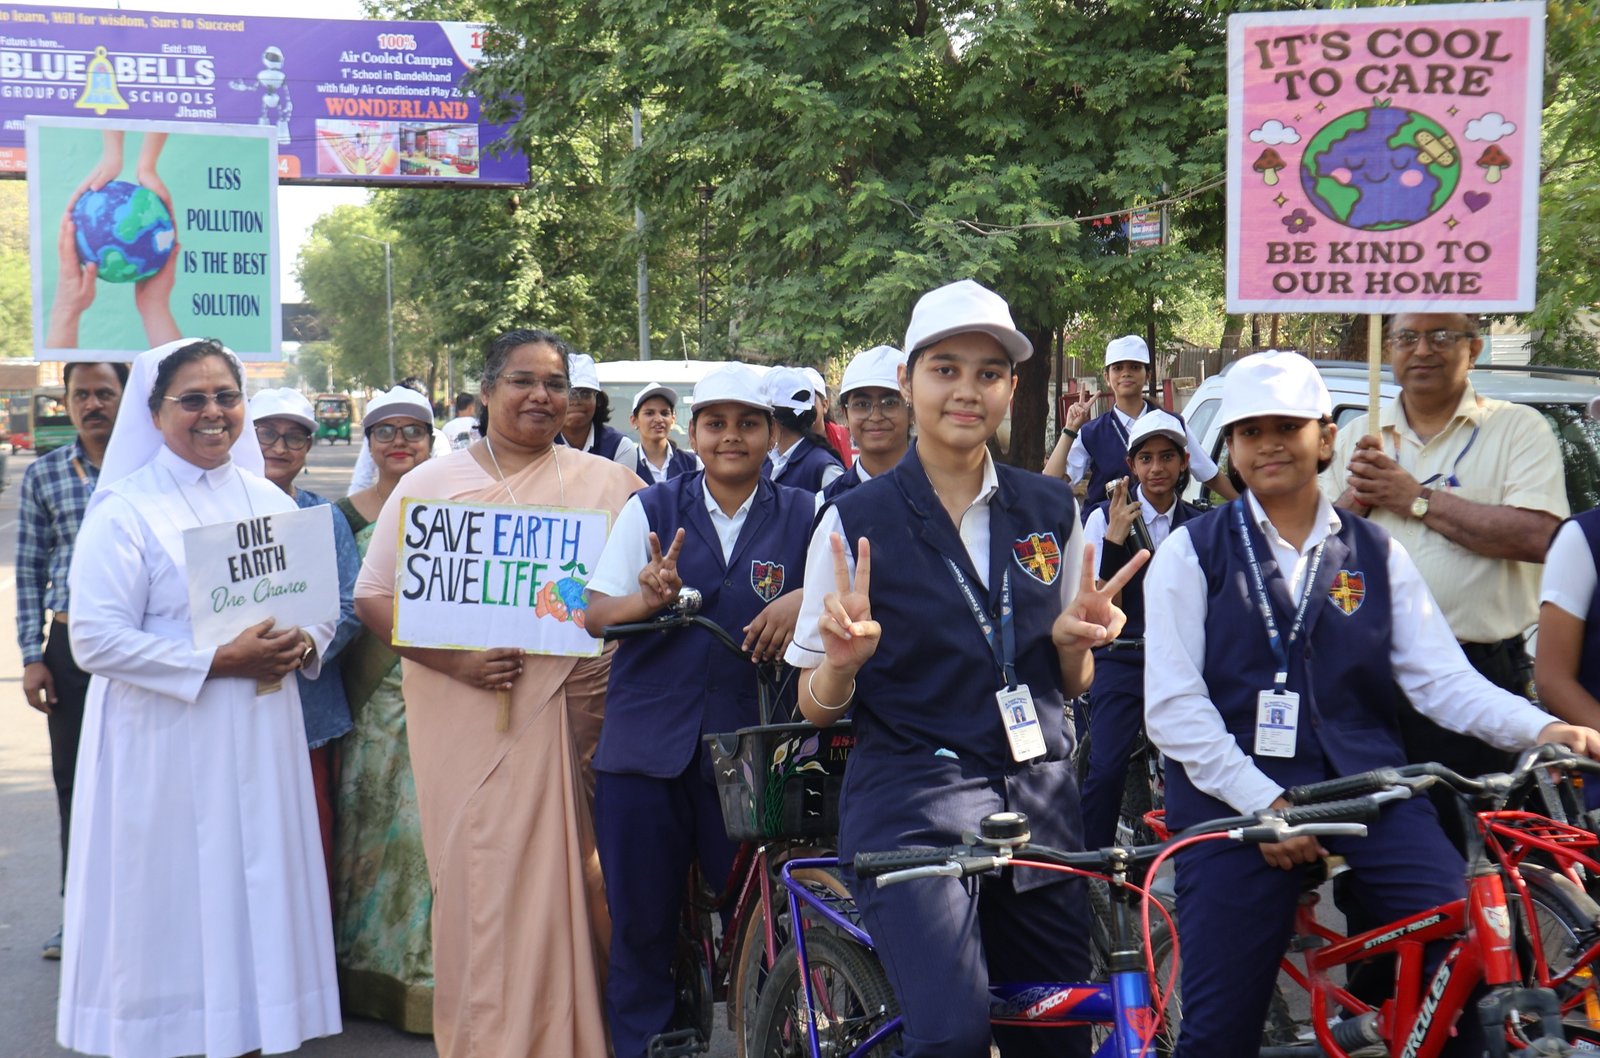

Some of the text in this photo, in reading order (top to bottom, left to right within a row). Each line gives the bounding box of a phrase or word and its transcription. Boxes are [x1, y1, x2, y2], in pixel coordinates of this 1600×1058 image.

[51, 11, 75, 25] Will
[77, 13, 96, 26] for
[99, 14, 148, 29] wisdom,
[150, 16, 178, 29] Sure
[181, 18, 194, 30] to
[196, 18, 244, 32] Succeed
[377, 33, 417, 50] 100%
[1254, 28, 1513, 70] IT'S COOL
[1, 51, 216, 86] BLUE BELLS
[339, 51, 360, 63] Air
[361, 52, 403, 65] Cooled
[405, 54, 453, 68] Campus
[352, 69, 382, 80] School
[383, 70, 393, 80] in
[394, 71, 451, 82] Bundelkhand
[1274, 64, 1494, 101] TO CARE
[2, 86, 214, 105] GROUP OF SCHOOLS
[317, 83, 338, 93] with
[339, 83, 360, 96] fully
[361, 85, 374, 95] Air
[376, 85, 430, 97] Conditioned
[431, 87, 450, 99] Play
[176, 106, 217, 119] Jhansi
[325, 97, 469, 120] WONDERLAND
[208, 167, 241, 190] LESS
[187, 208, 264, 233] POLLUTION
[184, 250, 268, 275] IS THE BEST
[1266, 240, 1492, 264] BE KIND TO
[1272, 271, 1483, 294] OUR HOME
[192, 292, 260, 317] SOLUTION
[236, 516, 274, 549] ONE
[405, 505, 582, 561] SAVE EARTH
[227, 545, 287, 583] EARTH
[1247, 546, 1256, 562] Inter
[402, 553, 548, 608] SAVE LIFE
[1251, 562, 1264, 590] Convent
[1304, 572, 1317, 597] Convent
[1311, 556, 1321, 572] Inter
[211, 577, 308, 613] One Chance
[1363, 914, 1441, 950] STREET RIDER
[1400, 960, 1451, 1058] ERCULES
